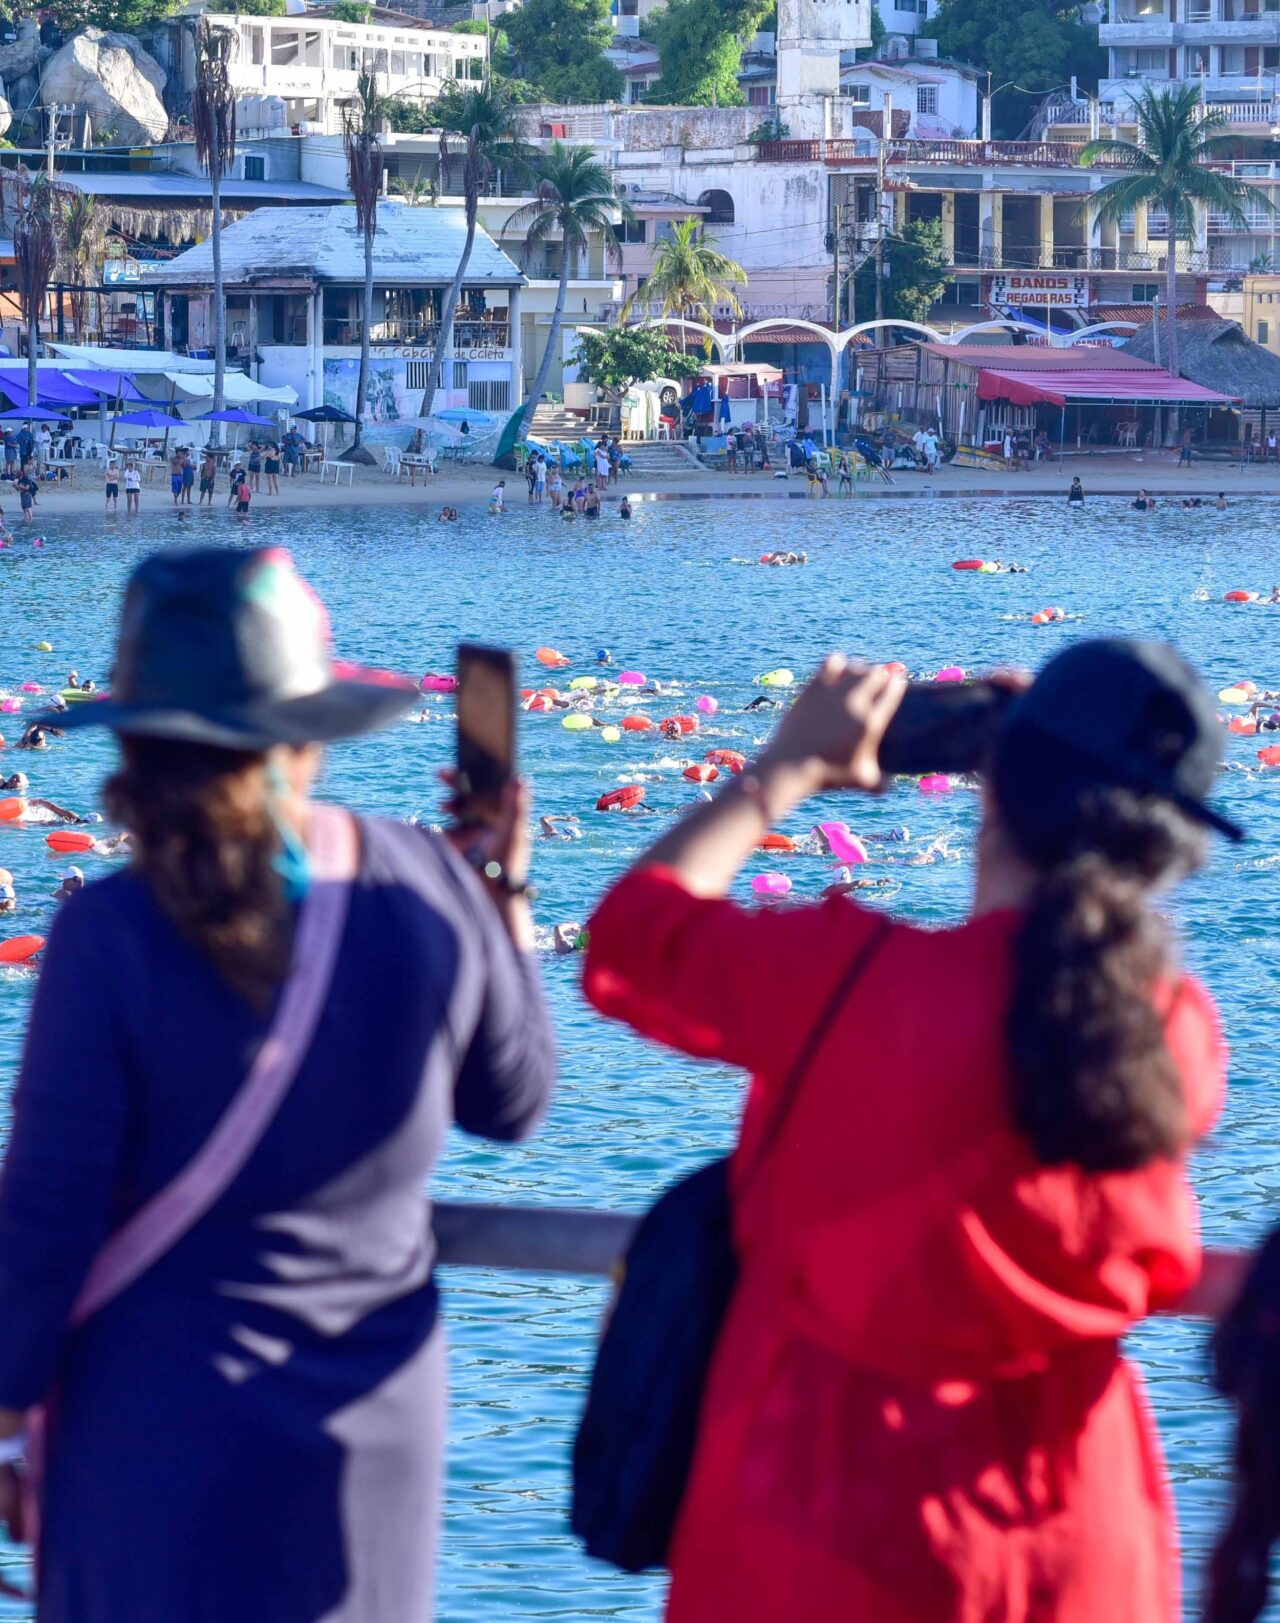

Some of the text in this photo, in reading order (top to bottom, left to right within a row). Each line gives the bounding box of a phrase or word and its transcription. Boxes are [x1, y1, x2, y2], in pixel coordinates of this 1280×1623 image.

[1010, 276, 1068, 288] BAÑOS
[1006, 292, 1073, 304] REGADERAS
[454, 349, 466, 359] de
[469, 348, 504, 360] Caleta
